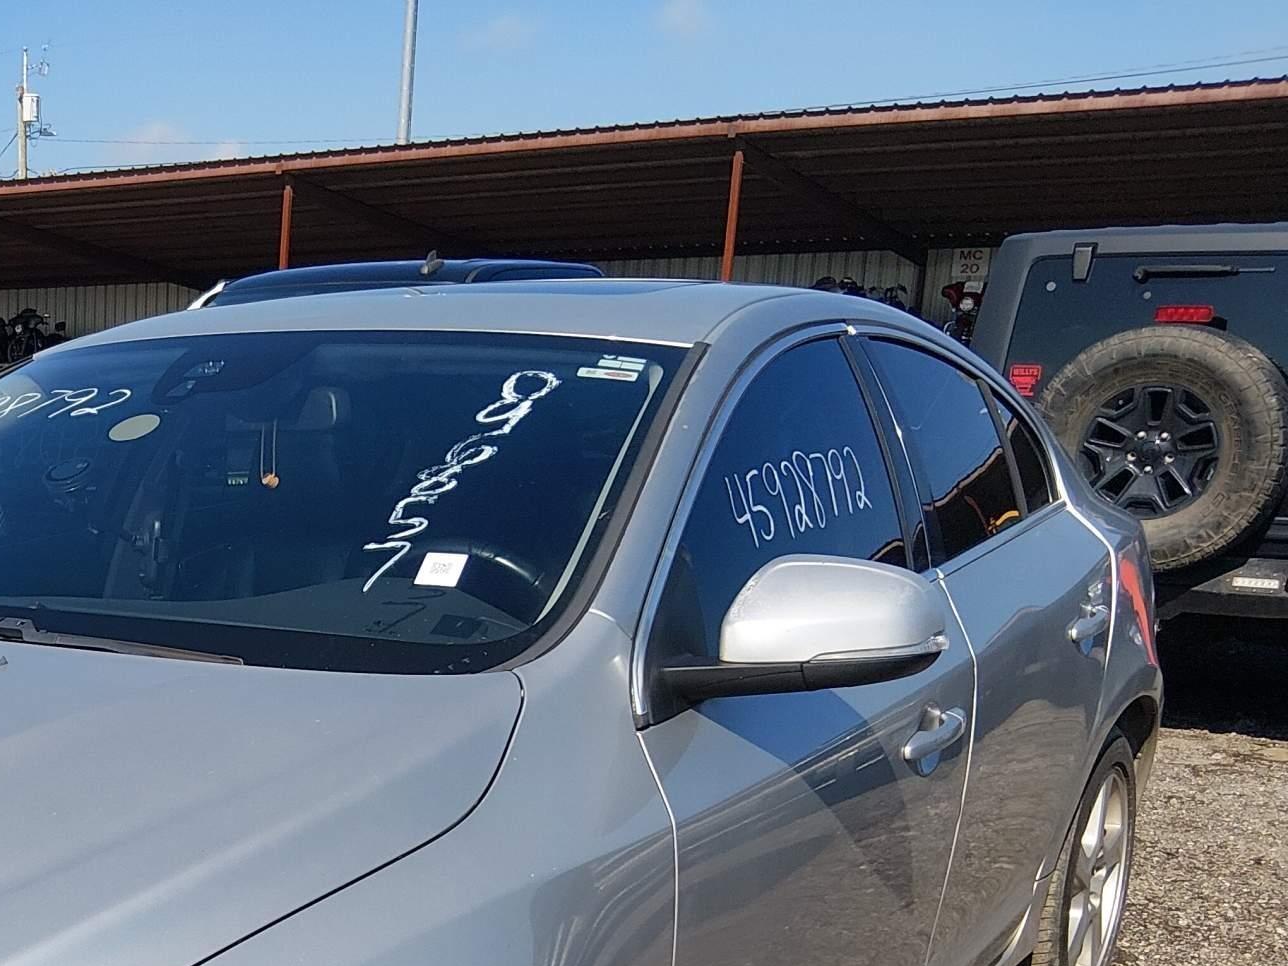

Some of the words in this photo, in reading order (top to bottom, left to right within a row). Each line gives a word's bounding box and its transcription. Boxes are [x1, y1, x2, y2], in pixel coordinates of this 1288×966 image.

[959, 249, 984, 260] MC
[959, 263, 980, 274] 20
[725, 446, 873, 549] 45928792
